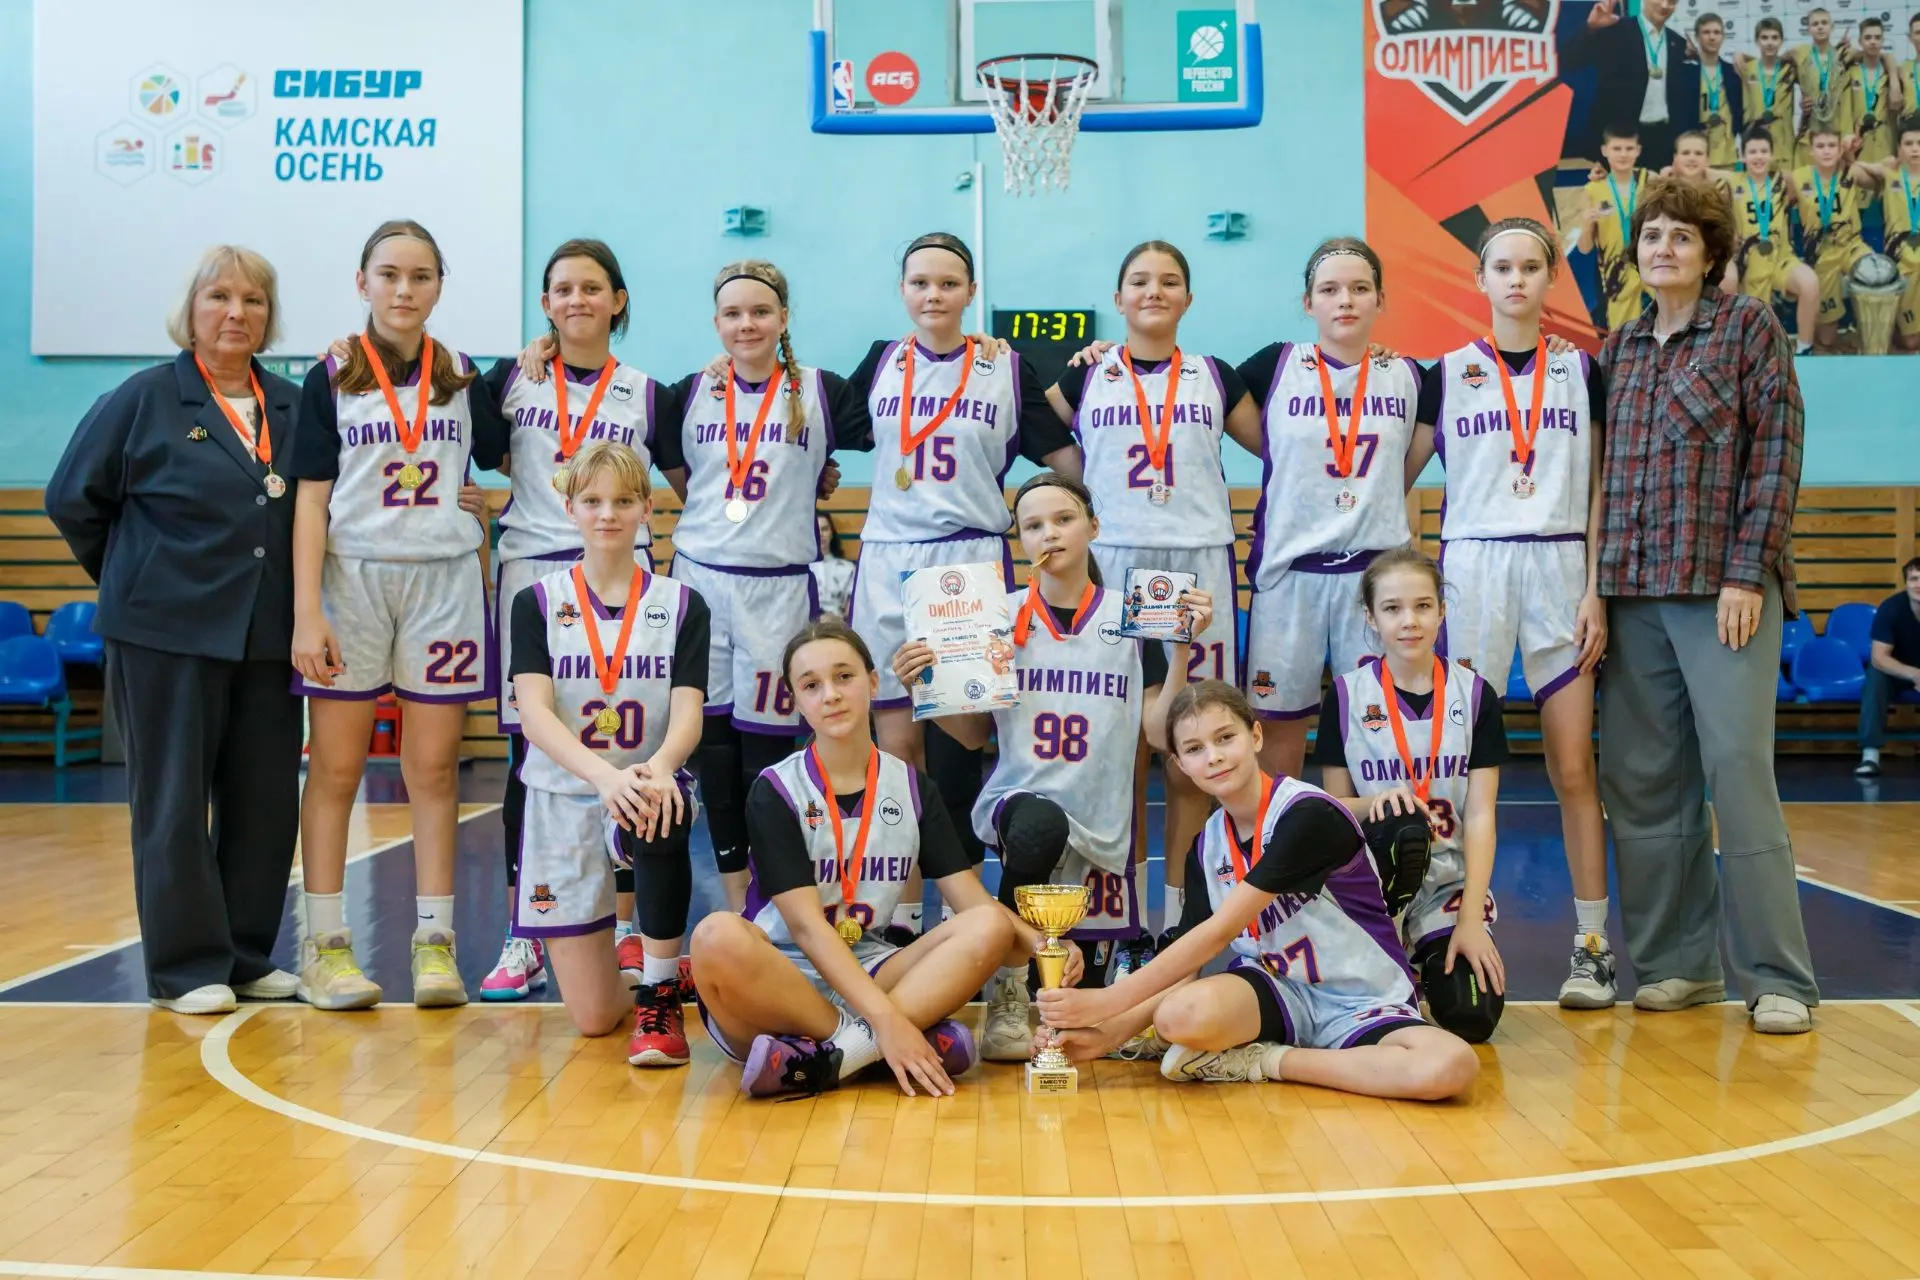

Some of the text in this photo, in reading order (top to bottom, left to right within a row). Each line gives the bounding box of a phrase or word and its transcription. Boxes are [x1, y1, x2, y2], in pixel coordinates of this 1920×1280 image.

[273, 69, 422, 98] СИБУР
[1382, 36, 1548, 91] ОЛИМПИЕЦ
[274, 117, 437, 147] КАМСКАЯ
[274, 151, 384, 181] ОСЕНЬ
[1011, 312, 1086, 341] 17:37
[612, 386, 631, 395] РФБ
[914, 436, 956, 481] 15
[1127, 443, 1174, 488] 21
[382, 460, 439, 507] 22
[425, 640, 478, 684] 22
[1187, 640, 1224, 684] 21
[754, 670, 796, 717] 16
[1016, 668, 1129, 703] ЛИМПИЕЦ
[580, 698, 645, 749] 20
[1032, 711, 1089, 763] 98
